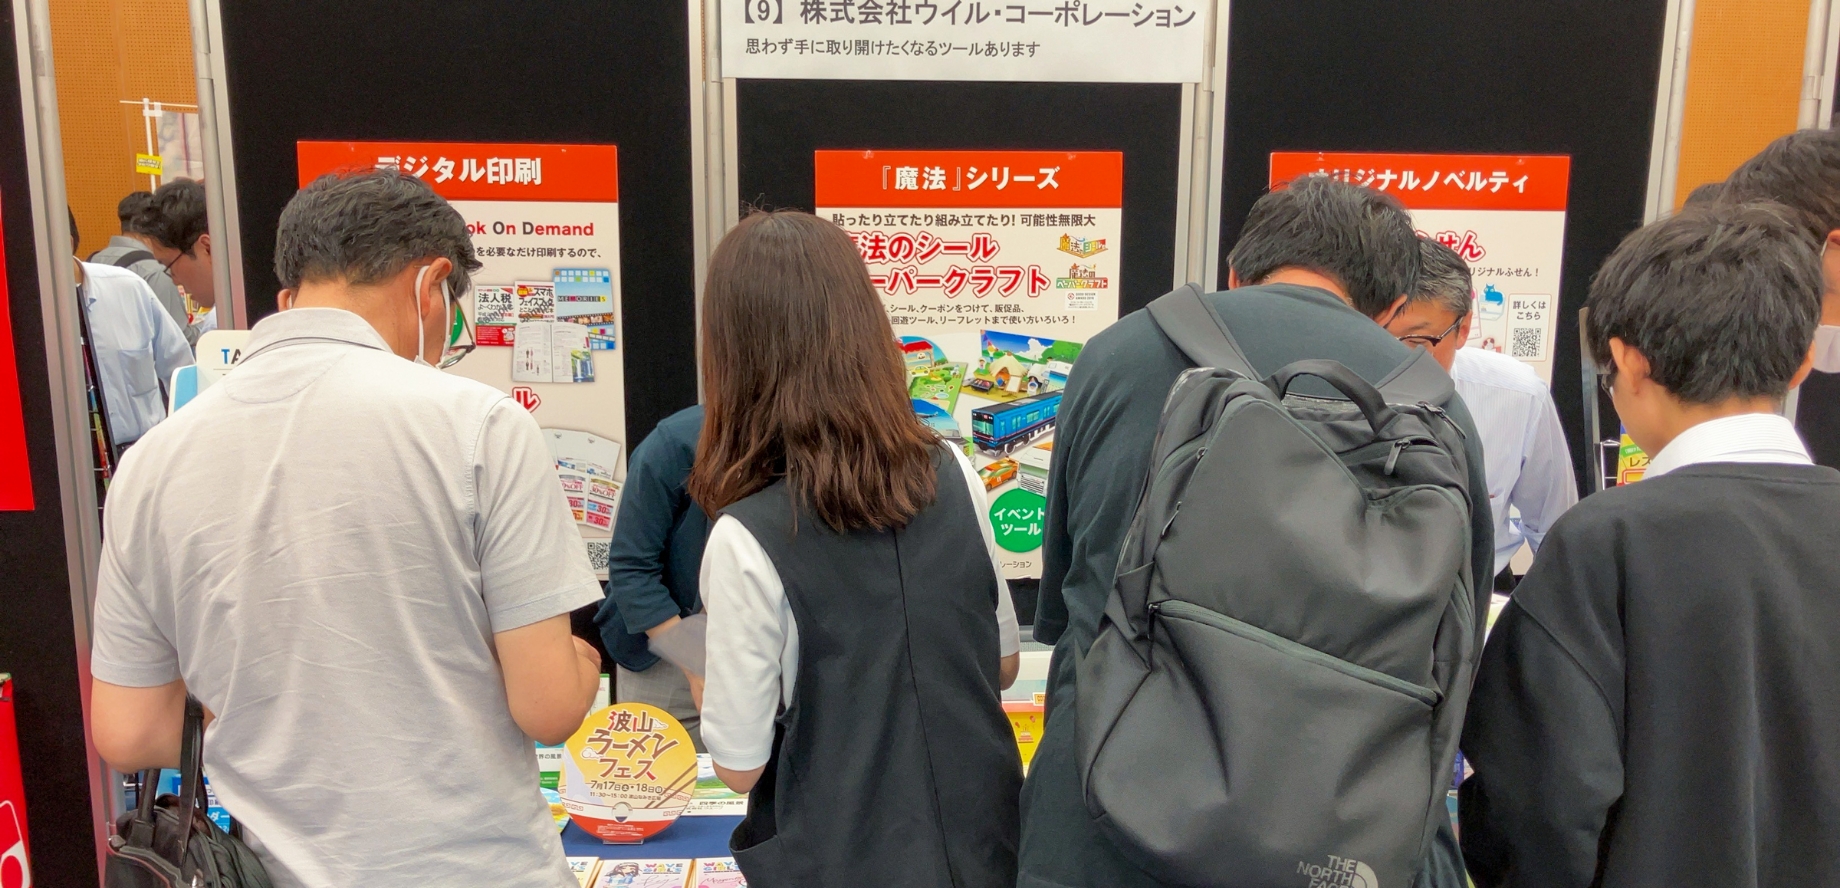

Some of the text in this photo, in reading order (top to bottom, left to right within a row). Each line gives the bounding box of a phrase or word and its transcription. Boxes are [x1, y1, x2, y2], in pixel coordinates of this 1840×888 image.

[744, 0, 1197, 28] 【9】 株式会社ウイル・コーポレーション
[745, 38, 1041, 57] 思わず手に取り開けたくなるツールあります
[881, 165, 1061, 192] 『魔法』シリーズ
[493, 221, 516, 236] On
[522, 222, 594, 236] Demand
[832, 213, 1096, 227] 貼ったり立てたり組み立てたり! 可能性無限大
[476, 246, 602, 258] を必要なだけ印刷するので、
[849, 231, 999, 264] 法のシール
[1415, 230, 1486, 262] せん
[478, 292, 513, 304] 法人税
[1513, 301, 1546, 310] 詳しくは
[1517, 312, 1542, 321] こちら
[1000, 523, 1042, 536] ツール
[609, 710, 653, 733] 波山
[586, 728, 679, 760] ラーメン
[599, 758, 656, 781] フェス
[1327, 854, 1357, 873] THE
[1296, 861, 1354, 886] NORTH
[1308, 877, 1354, 888] FA
